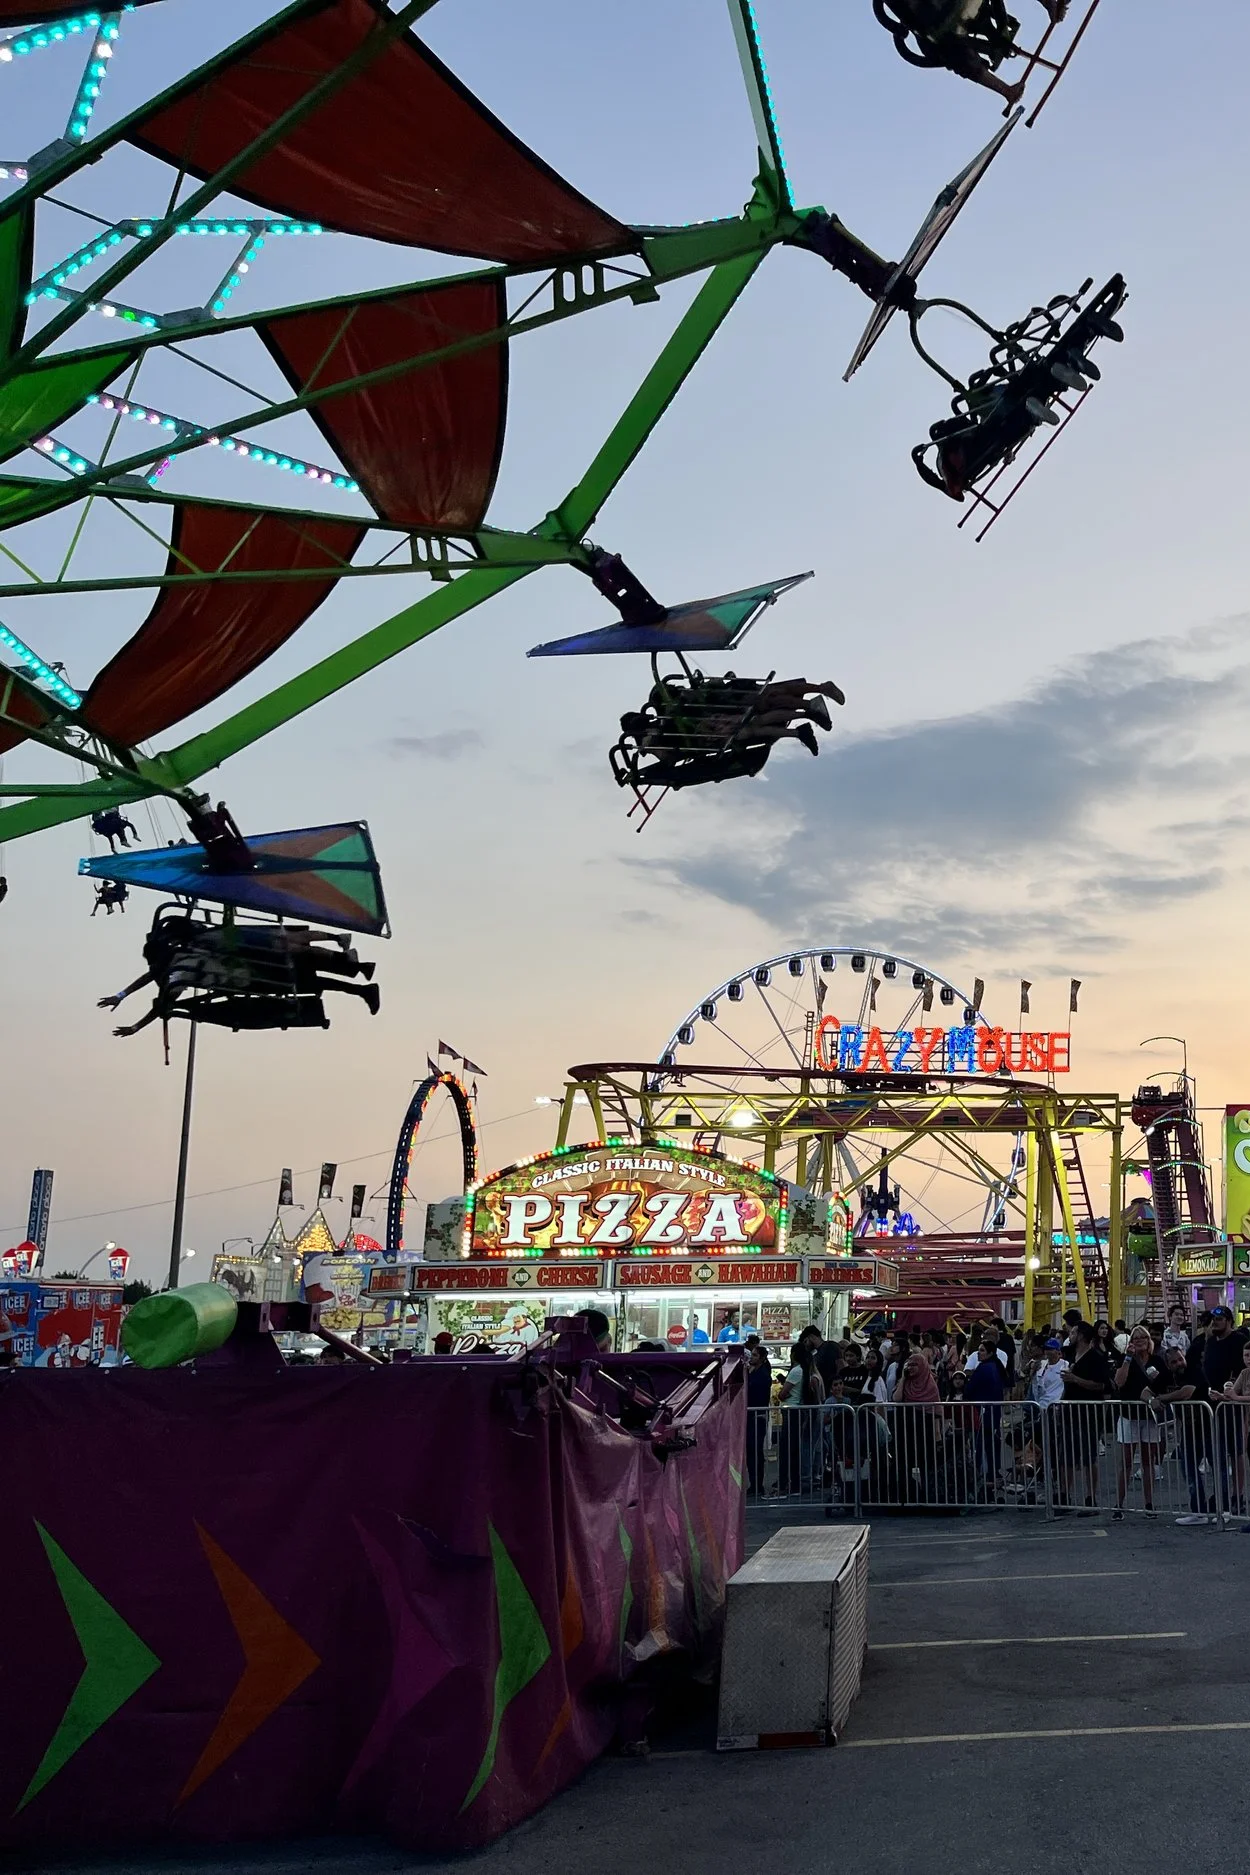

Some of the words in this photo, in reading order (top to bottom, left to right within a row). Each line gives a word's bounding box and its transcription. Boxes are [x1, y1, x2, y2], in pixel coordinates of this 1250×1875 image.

[814, 1015, 944, 1073] CRAZY
[947, 1025, 1071, 1073] MOUSE
[531, 1160, 601, 1189] CLASSIC
[605, 1157, 674, 1173] ITALIAN
[678, 1163, 727, 1188] STYLE
[499, 1191, 749, 1247] PIZZA
[417, 1267, 509, 1288] PEPPERONI
[514, 1272, 528, 1282] AND
[536, 1266, 598, 1287] CHEESE
[619, 1264, 692, 1285] SAUSAGE
[699, 1269, 712, 1278] AND
[718, 1262, 798, 1283] HAWAIIAN
[1185, 1258, 1219, 1273] LEMONADE
[762, 1306, 790, 1315] PIZZA
